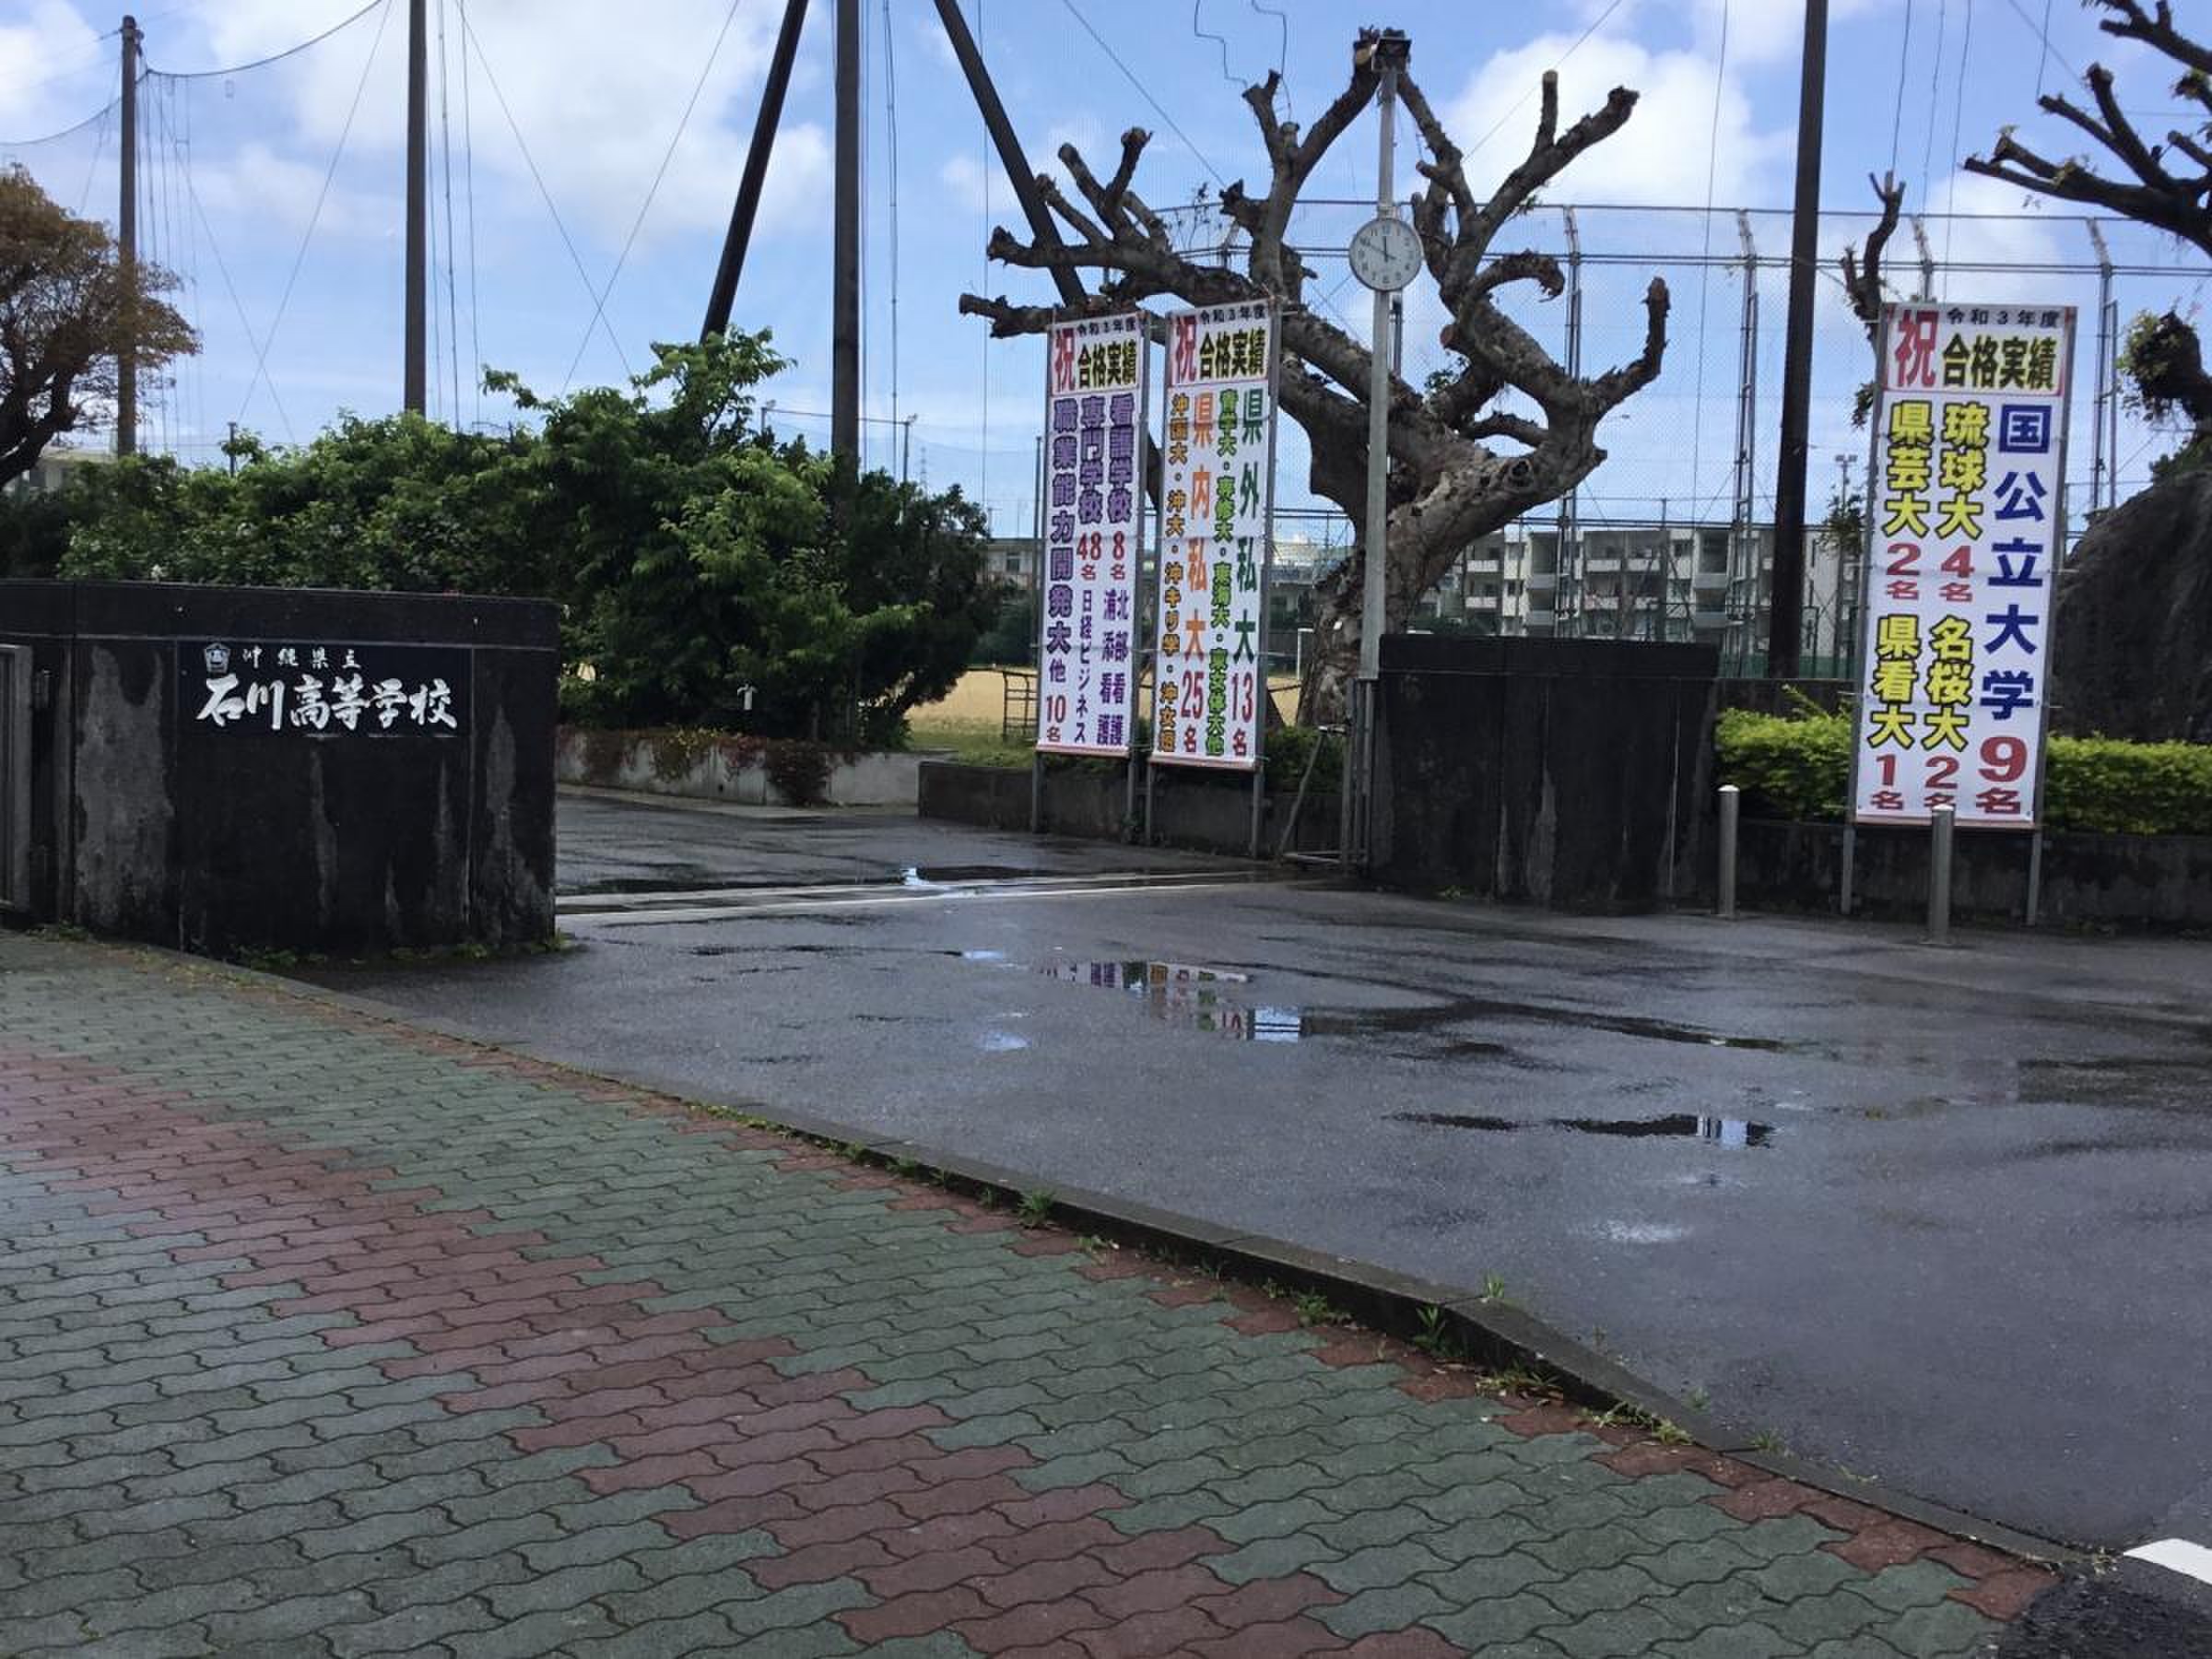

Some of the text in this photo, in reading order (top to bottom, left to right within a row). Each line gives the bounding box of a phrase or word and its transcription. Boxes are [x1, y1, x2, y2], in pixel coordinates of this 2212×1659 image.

[1947, 308, 2060, 328] 令和3年度
[1054, 327, 1076, 391] 祝
[1078, 339, 1136, 389] 合格実績
[1175, 315, 1196, 382] 祝
[1199, 327, 1265, 381] 合格実績
[1895, 310, 1938, 388] 祝
[1943, 334, 2057, 390] 合格実績
[241, 645, 361, 669] 沖縄県立
[195, 673, 458, 730] 石川高等学校
